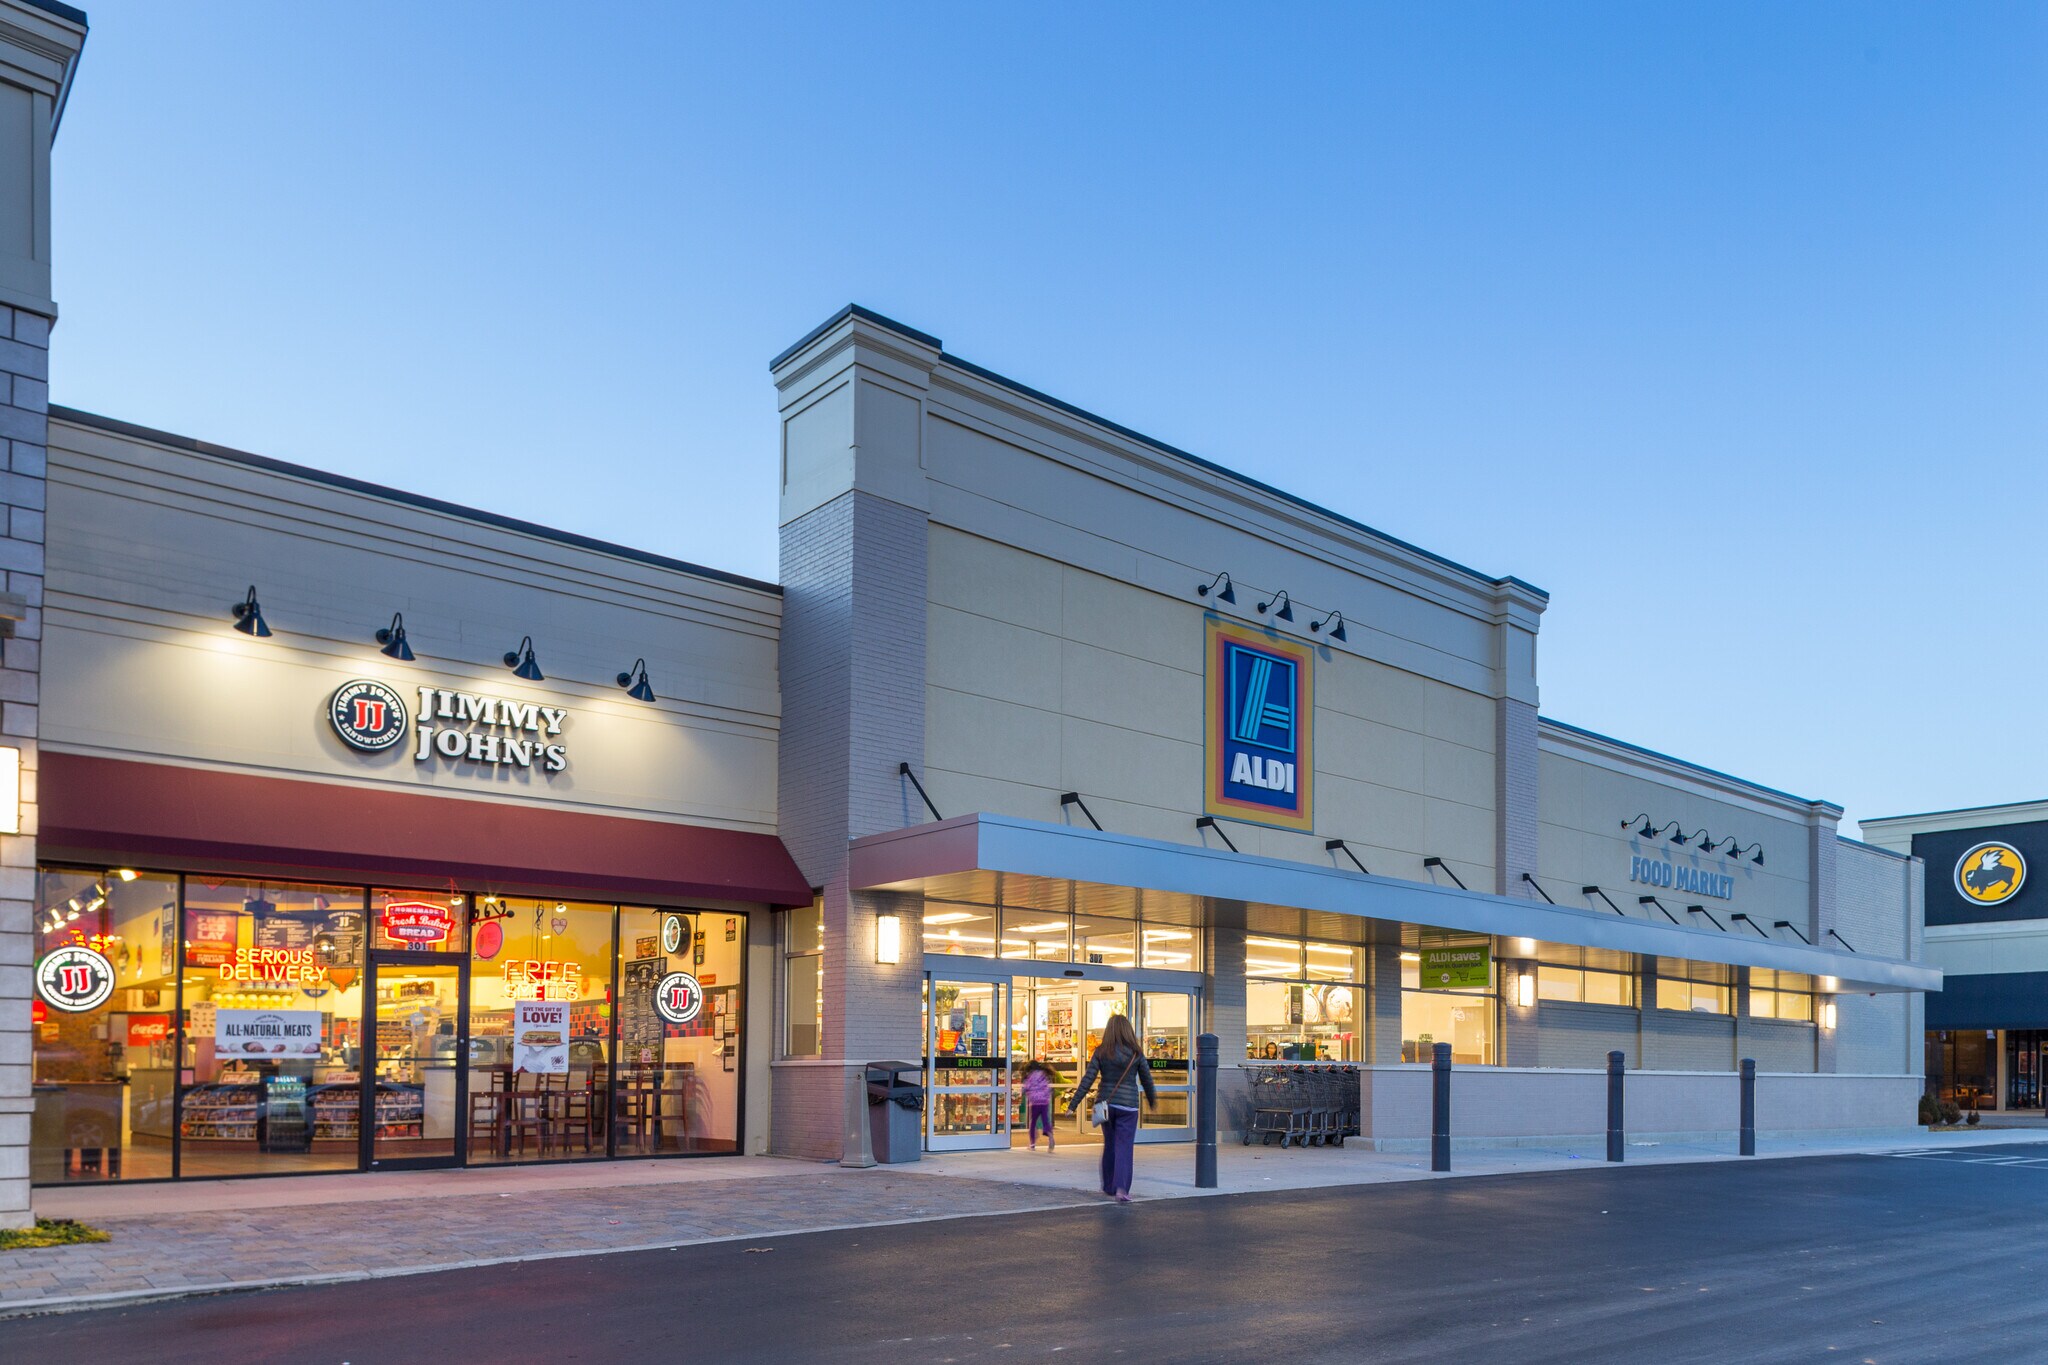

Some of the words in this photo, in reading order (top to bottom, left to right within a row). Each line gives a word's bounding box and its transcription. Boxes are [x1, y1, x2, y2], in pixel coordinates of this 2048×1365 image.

[337, 685, 368, 713] JIMMY
[369, 686, 402, 720] JOHN'S
[417, 686, 567, 735] JIMMY
[353, 698, 387, 732] JJ
[341, 722, 398, 744] SANDWICHES
[414, 725, 567, 772] JOHN'S
[1230, 752, 1295, 794] ALDI
[1630, 855, 1672, 888] FOOD
[1674, 865, 1735, 900] MARKET
[394, 906, 439, 914] HOMEMADE
[387, 914, 416, 926] Fresh
[418, 915, 452, 930] Baked
[398, 927, 435, 937] BREAD
[408, 942, 427, 950] 301
[235, 948, 314, 964] SERIOUS
[1090, 953, 1103, 964] 302
[1429, 953, 1451, 962] ALDI
[1451, 952, 1481, 961] saves
[59, 965, 92, 995] JJ
[219, 963, 327, 982] DELIVERY
[504, 960, 579, 985] FREE
[503, 983, 578, 1001] SMELLS
[670, 987, 691, 1009] JJ
[523, 1012, 562, 1023] LOVE!
[225, 1024, 280, 1037] ALL-NATURAL
[284, 1024, 312, 1037] MEATS
[958, 1058, 983, 1067] ENTER
[1152, 1060, 1167, 1068] EXIT
